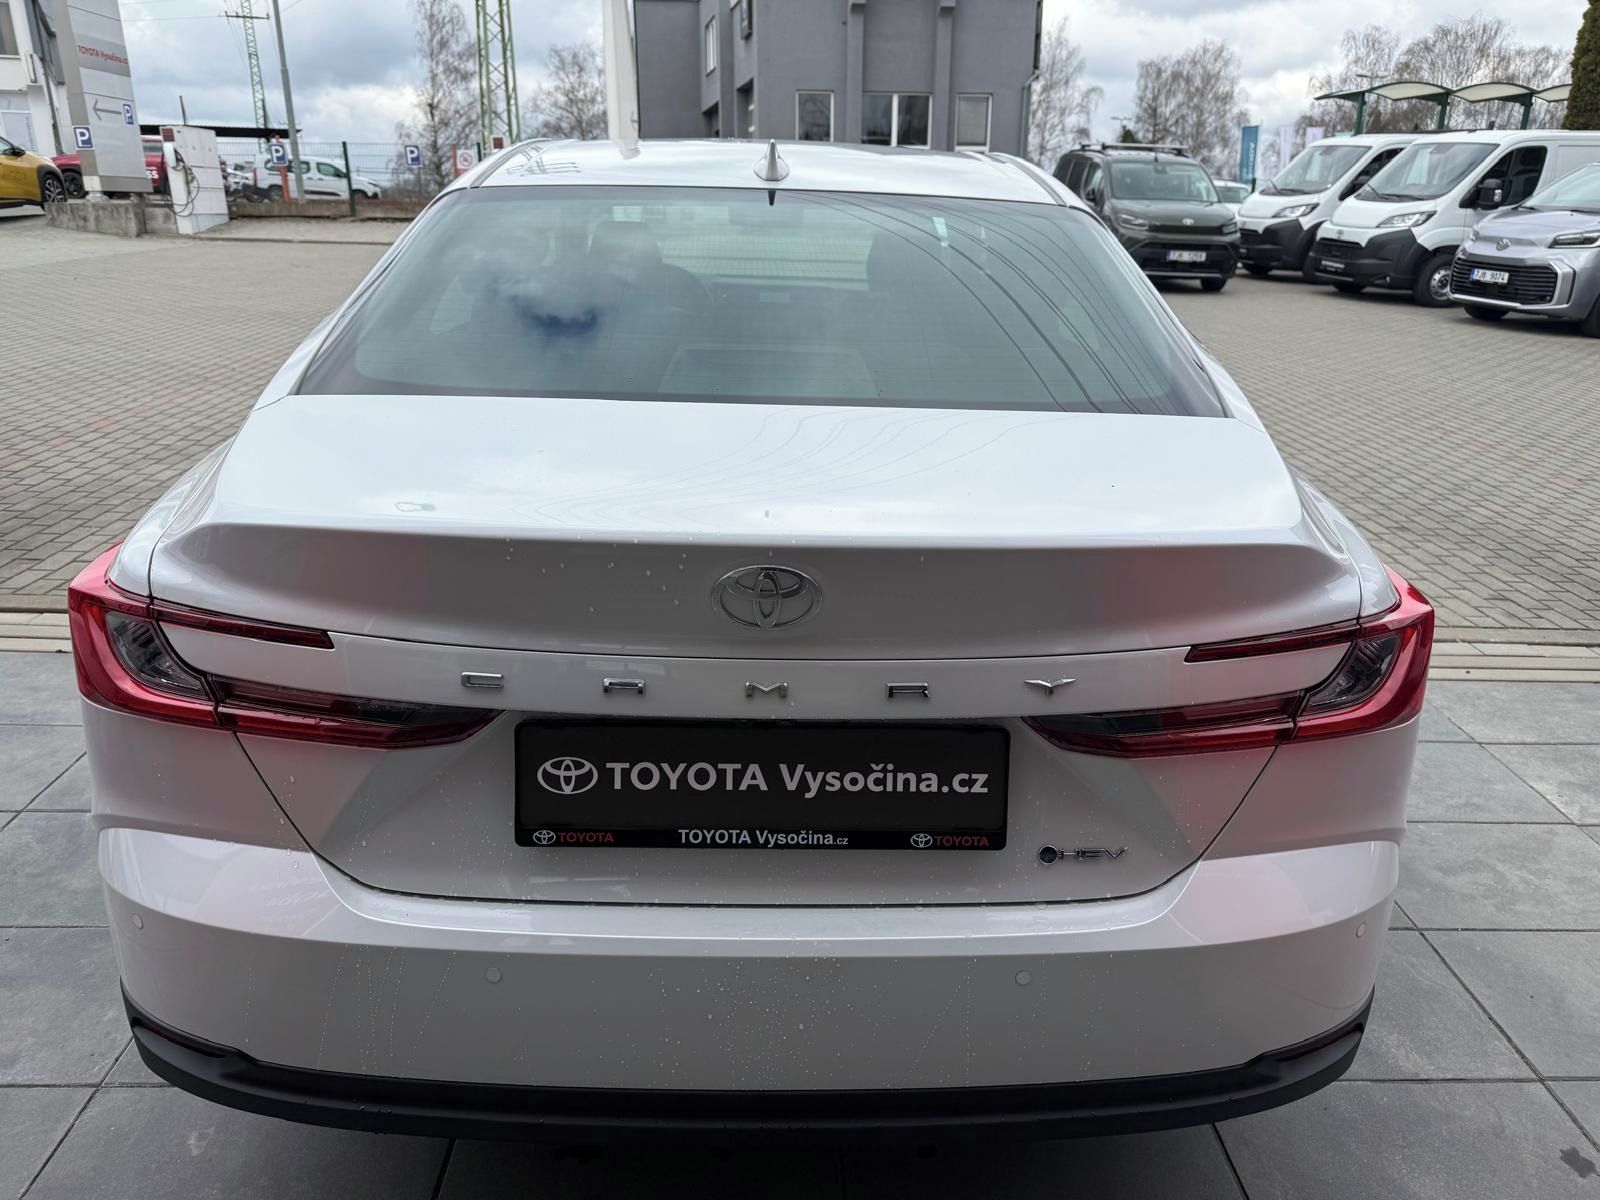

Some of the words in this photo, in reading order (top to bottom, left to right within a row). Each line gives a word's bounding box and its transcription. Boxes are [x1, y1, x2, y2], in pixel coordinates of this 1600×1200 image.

[77, 45, 99, 57] TOYOTA
[75, 129, 89, 147] P
[271, 145, 284, 163] P
[406, 147, 418, 165] P
[461, 671, 1077, 698] CAMRY
[605, 762, 769, 791] TOYOTA
[779, 763, 989, 799] Vysočina.cz
[559, 832, 614, 843] TOYOTA
[678, 829, 752, 844] TOYOTA
[755, 830, 849, 848] Vysočina.cz
[934, 836, 989, 847] TOYOTA
[1060, 847, 1128, 861] HEV
